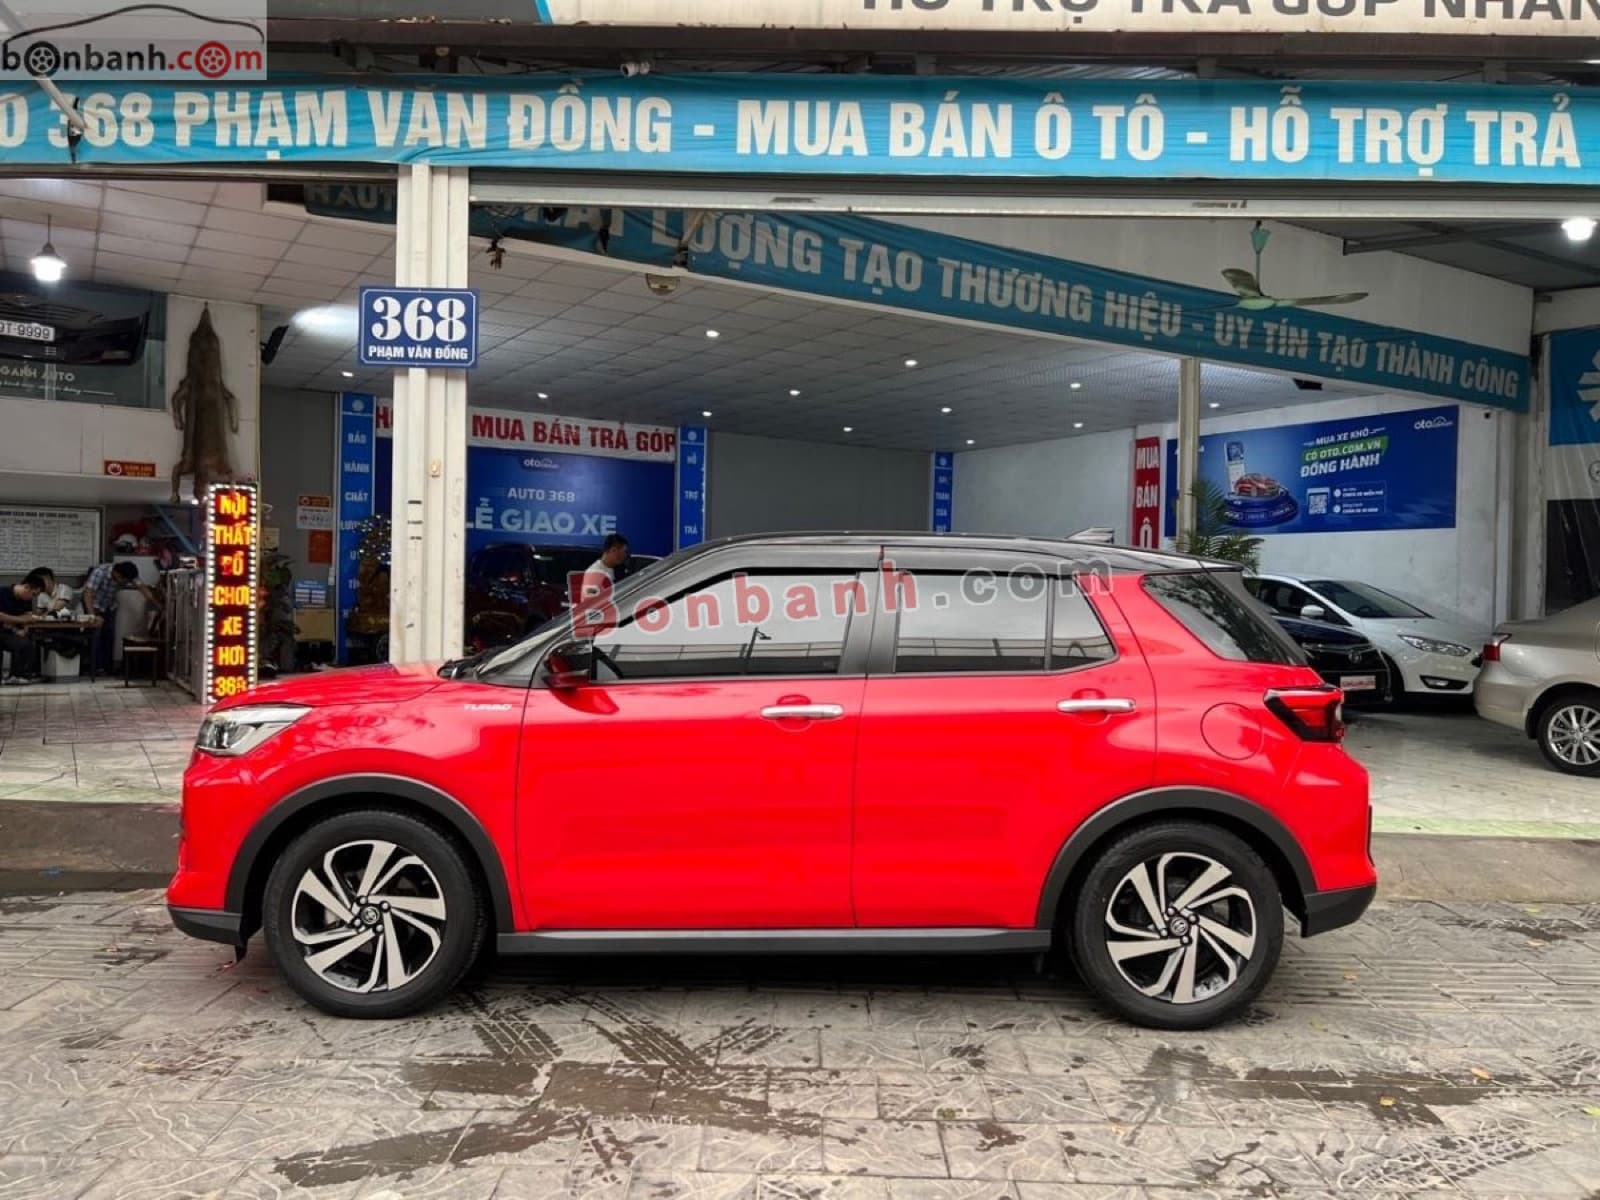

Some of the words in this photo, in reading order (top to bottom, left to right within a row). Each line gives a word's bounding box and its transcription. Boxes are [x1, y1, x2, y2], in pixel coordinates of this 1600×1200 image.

[48, 92, 154, 147] 368
[174, 91, 348, 160] PHẠM
[736, 99, 868, 156] MUA
[888, 90, 1013, 158] BÁN
[1034, 92, 1072, 160] Ô
[1092, 92, 1165, 161] TÔ
[1229, 86, 1310, 163] HỖ
[1330, 103, 1448, 177] TRỢ
[1466, 92, 1582, 168] TRẢ
[335, 183, 398, 211] AUT
[838, 237, 923, 296] TẠO
[937, 256, 1093, 323] THƯƠNG
[1103, 290, 1183, 341] HIỆU
[1214, 312, 1255, 350] UY
[1263, 314, 1309, 359] TÍN
[1318, 331, 1368, 372] TẠO
[1376, 340, 1455, 385] THÀNH
[1460, 358, 1519, 399] CÔNG
[371, 296, 467, 342] 368
[368, 345, 404, 360] PHẠM
[407, 344, 432, 359] VĂN
[472, 414, 525, 441] MUA
[533, 418, 580, 446] BÁN
[588, 421, 628, 450] TRẢ
[636, 428, 676, 453] GÓP
[1136, 446, 1159, 469] MUA
[1320, 440, 1381, 459] OTO.COM.VN
[1340, 453, 1380, 471] HÀNH
[507, 487, 544, 500] AUTO
[549, 489, 576, 502] 368
[1136, 481, 1158, 508] BÁN
[501, 508, 576, 536] GIAO
[582, 513, 617, 536] XE
[221, 616, 243, 635] XE
[215, 676, 247, 696] 368
